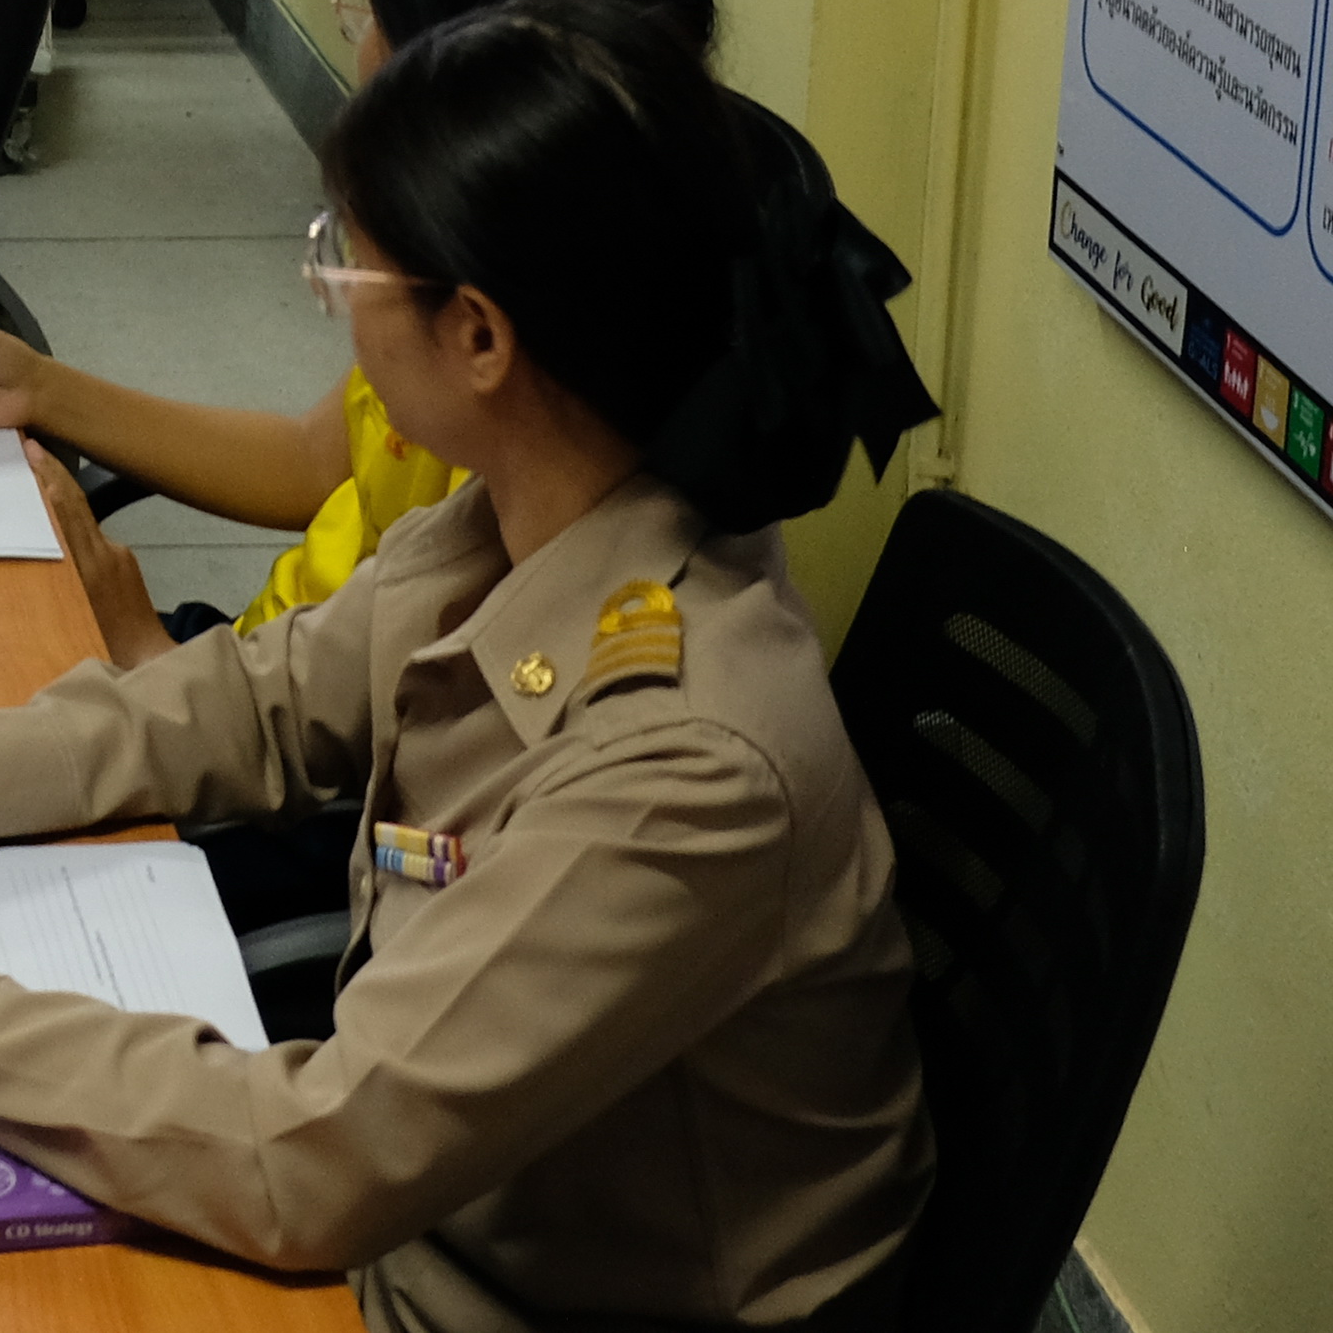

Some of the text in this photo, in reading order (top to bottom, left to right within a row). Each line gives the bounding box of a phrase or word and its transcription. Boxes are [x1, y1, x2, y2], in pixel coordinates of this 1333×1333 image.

[1060, 199, 1179, 332] Change for Good
